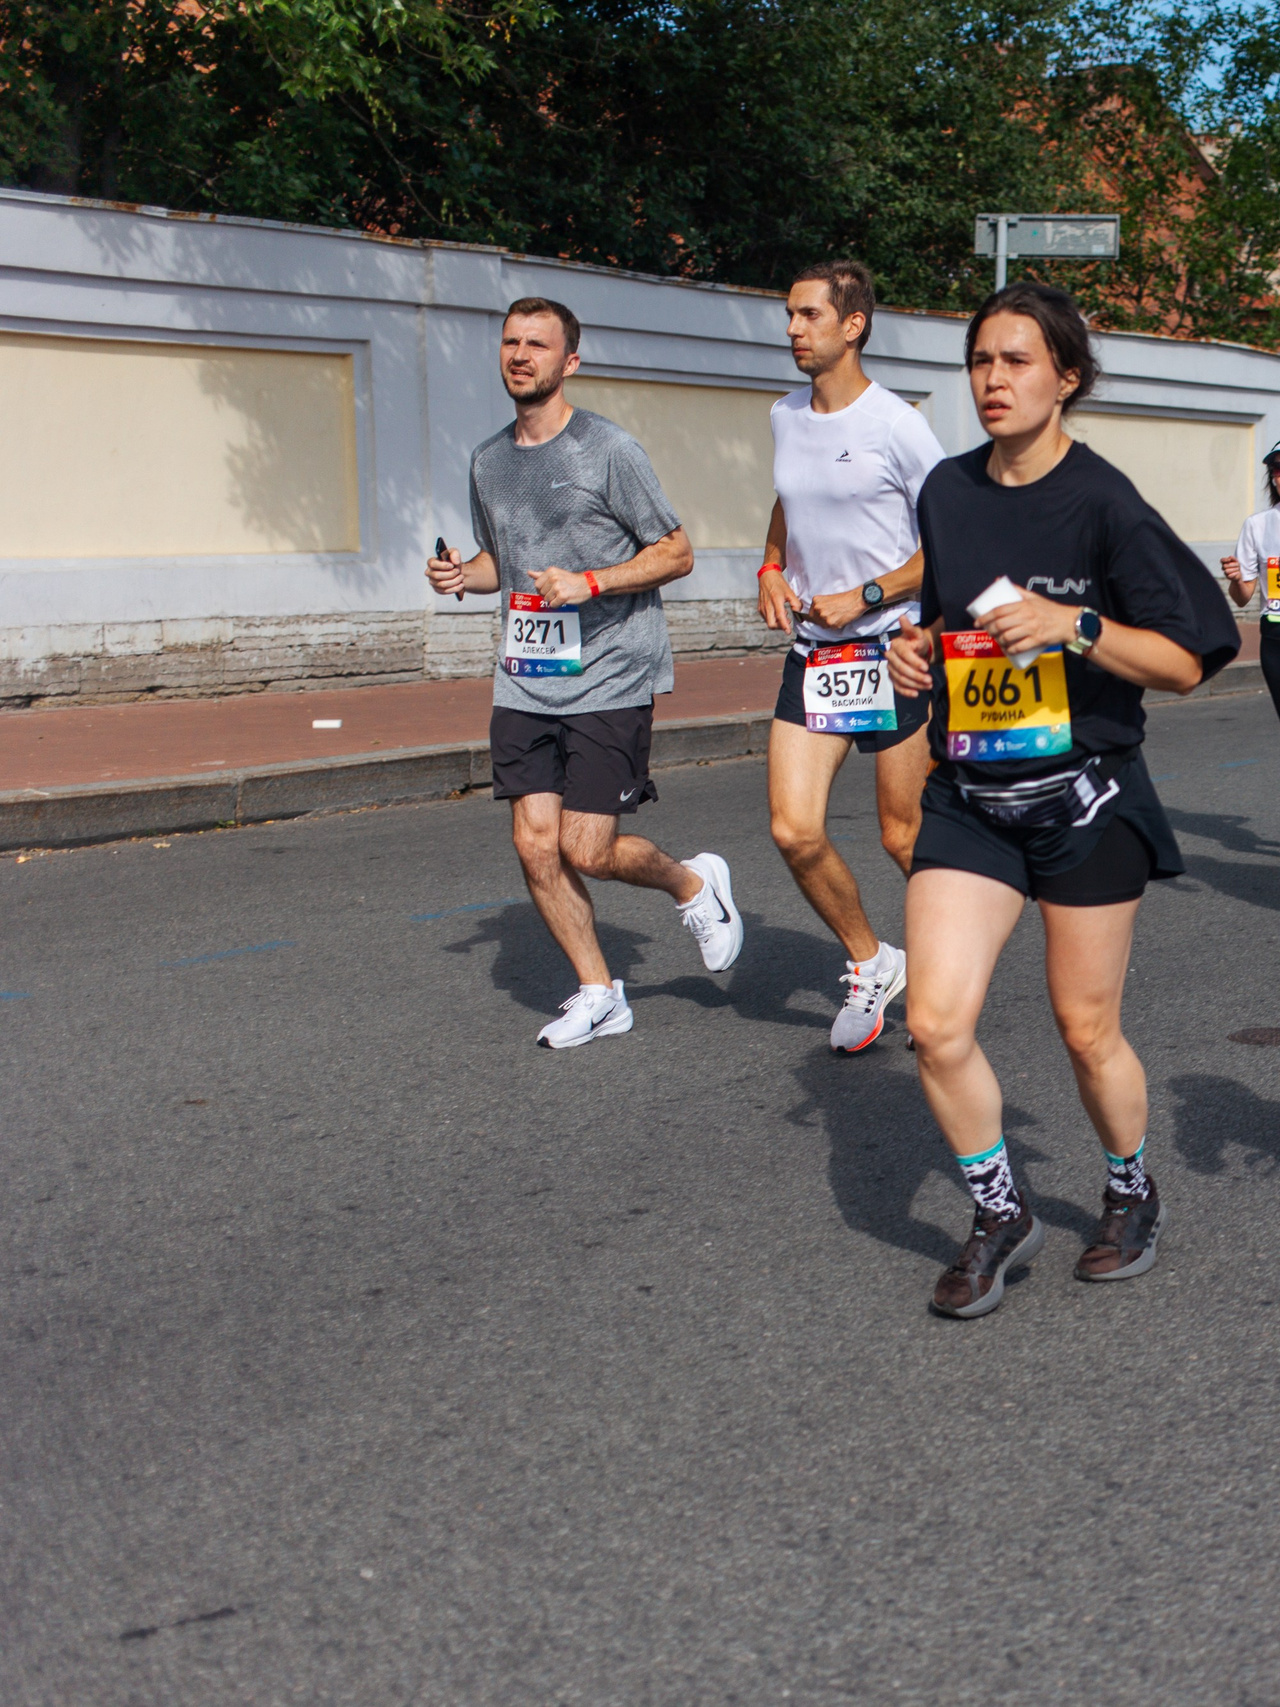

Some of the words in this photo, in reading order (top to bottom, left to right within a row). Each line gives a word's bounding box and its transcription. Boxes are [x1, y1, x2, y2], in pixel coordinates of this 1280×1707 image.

[514, 617, 565, 644] 3271
[522, 646, 556, 655] АЛЕКСЕЙ
[511, 659, 519, 674] D
[817, 669, 881, 698] 3579
[964, 666, 1042, 707] 6661
[832, 696, 874, 708] ВАСИЛИЙ
[816, 715, 827, 729] D
[981, 709, 1026, 722] РУФИНА
